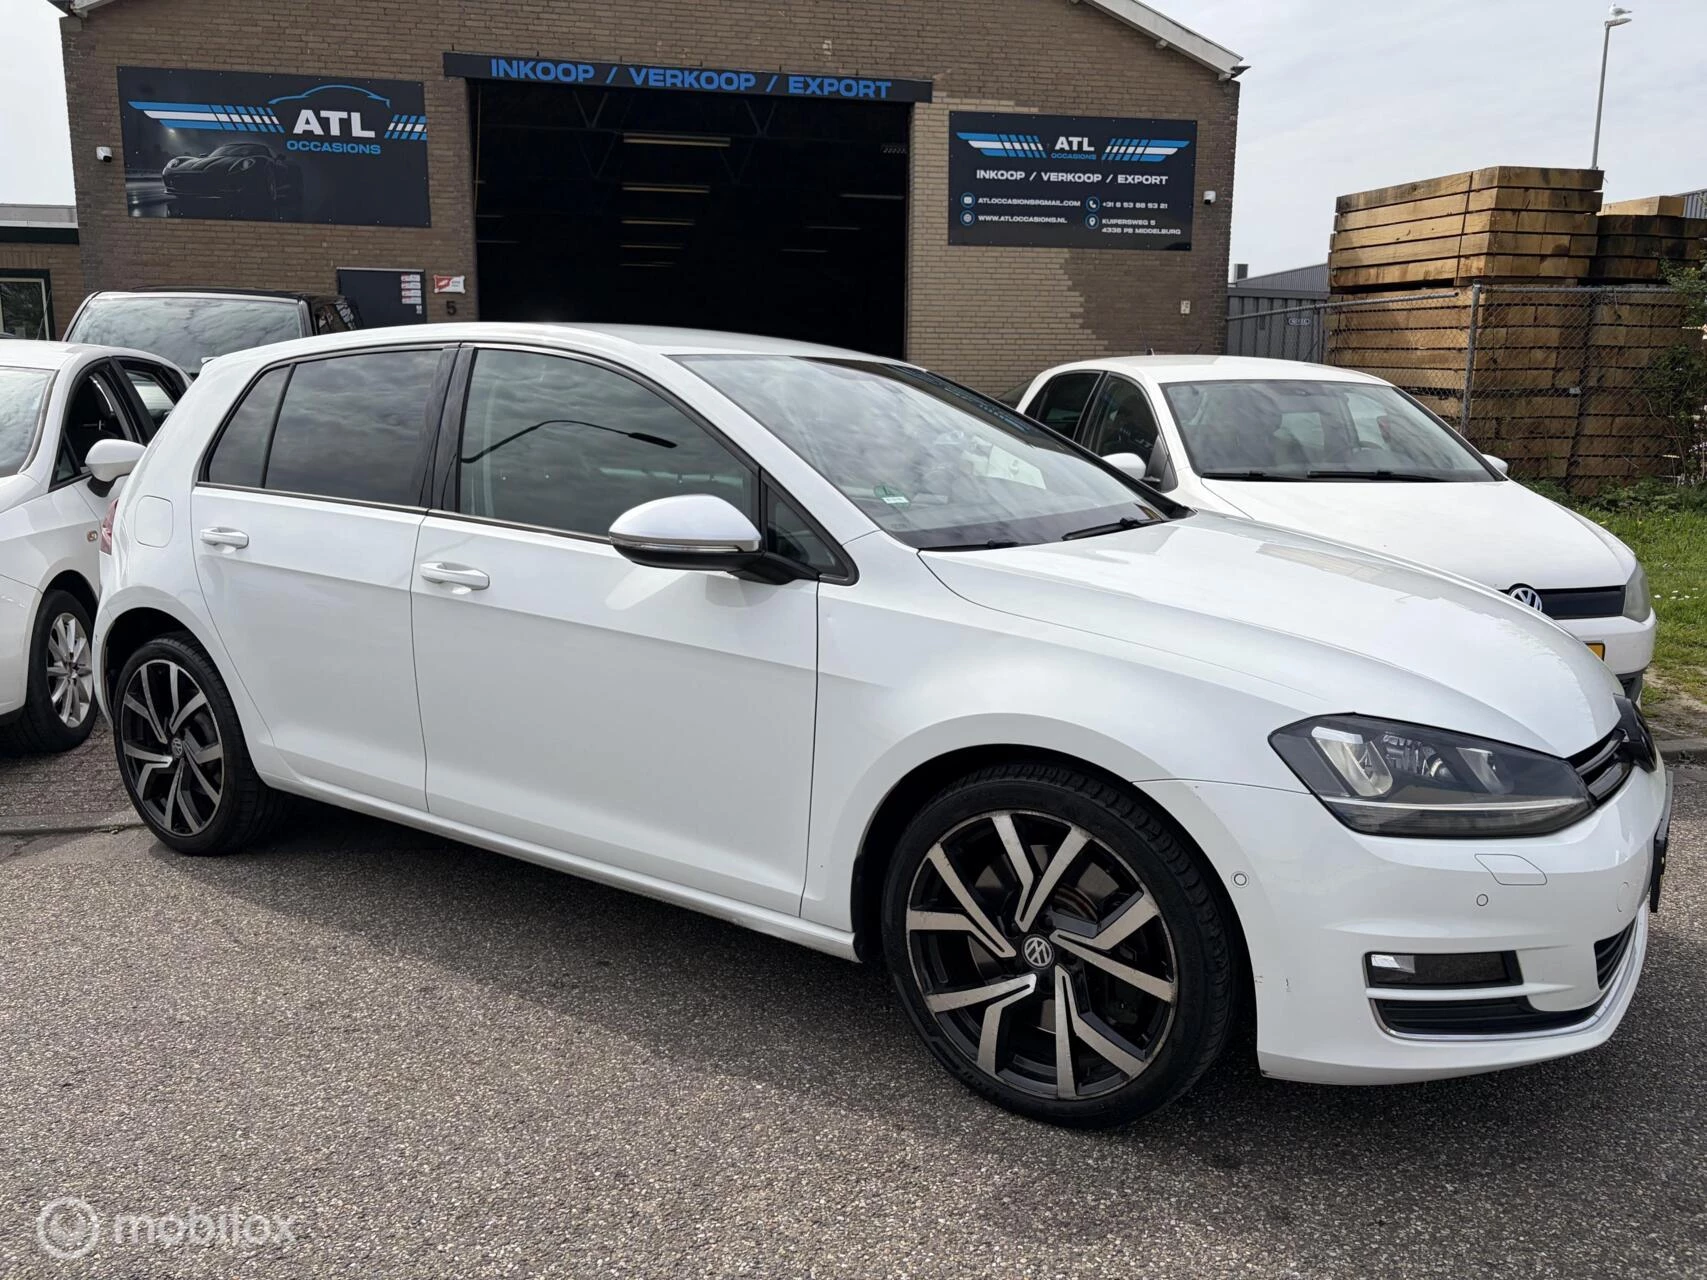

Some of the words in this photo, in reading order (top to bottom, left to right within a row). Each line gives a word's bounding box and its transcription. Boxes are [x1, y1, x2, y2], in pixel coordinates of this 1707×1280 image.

[490, 58, 595, 83] INKOOP
[606, 66, 618, 84] /
[629, 67, 756, 91] VERKOOP
[766, 75, 778, 93] /
[788, 76, 892, 98] EXPORT
[292, 109, 376, 138] ATL
[286, 140, 381, 155] OCCASIONS
[1054, 136, 1095, 151] ATL
[1050, 152, 1097, 160] OCCASIONS
[976, 169, 1026, 181] INKOOP
[1029, 172, 1037, 181] /
[1041, 172, 1102, 183] VERKOOP
[1106, 174, 1113, 183] /
[1117, 174, 1169, 185] EXPORT
[446, 300, 457, 316] 5
